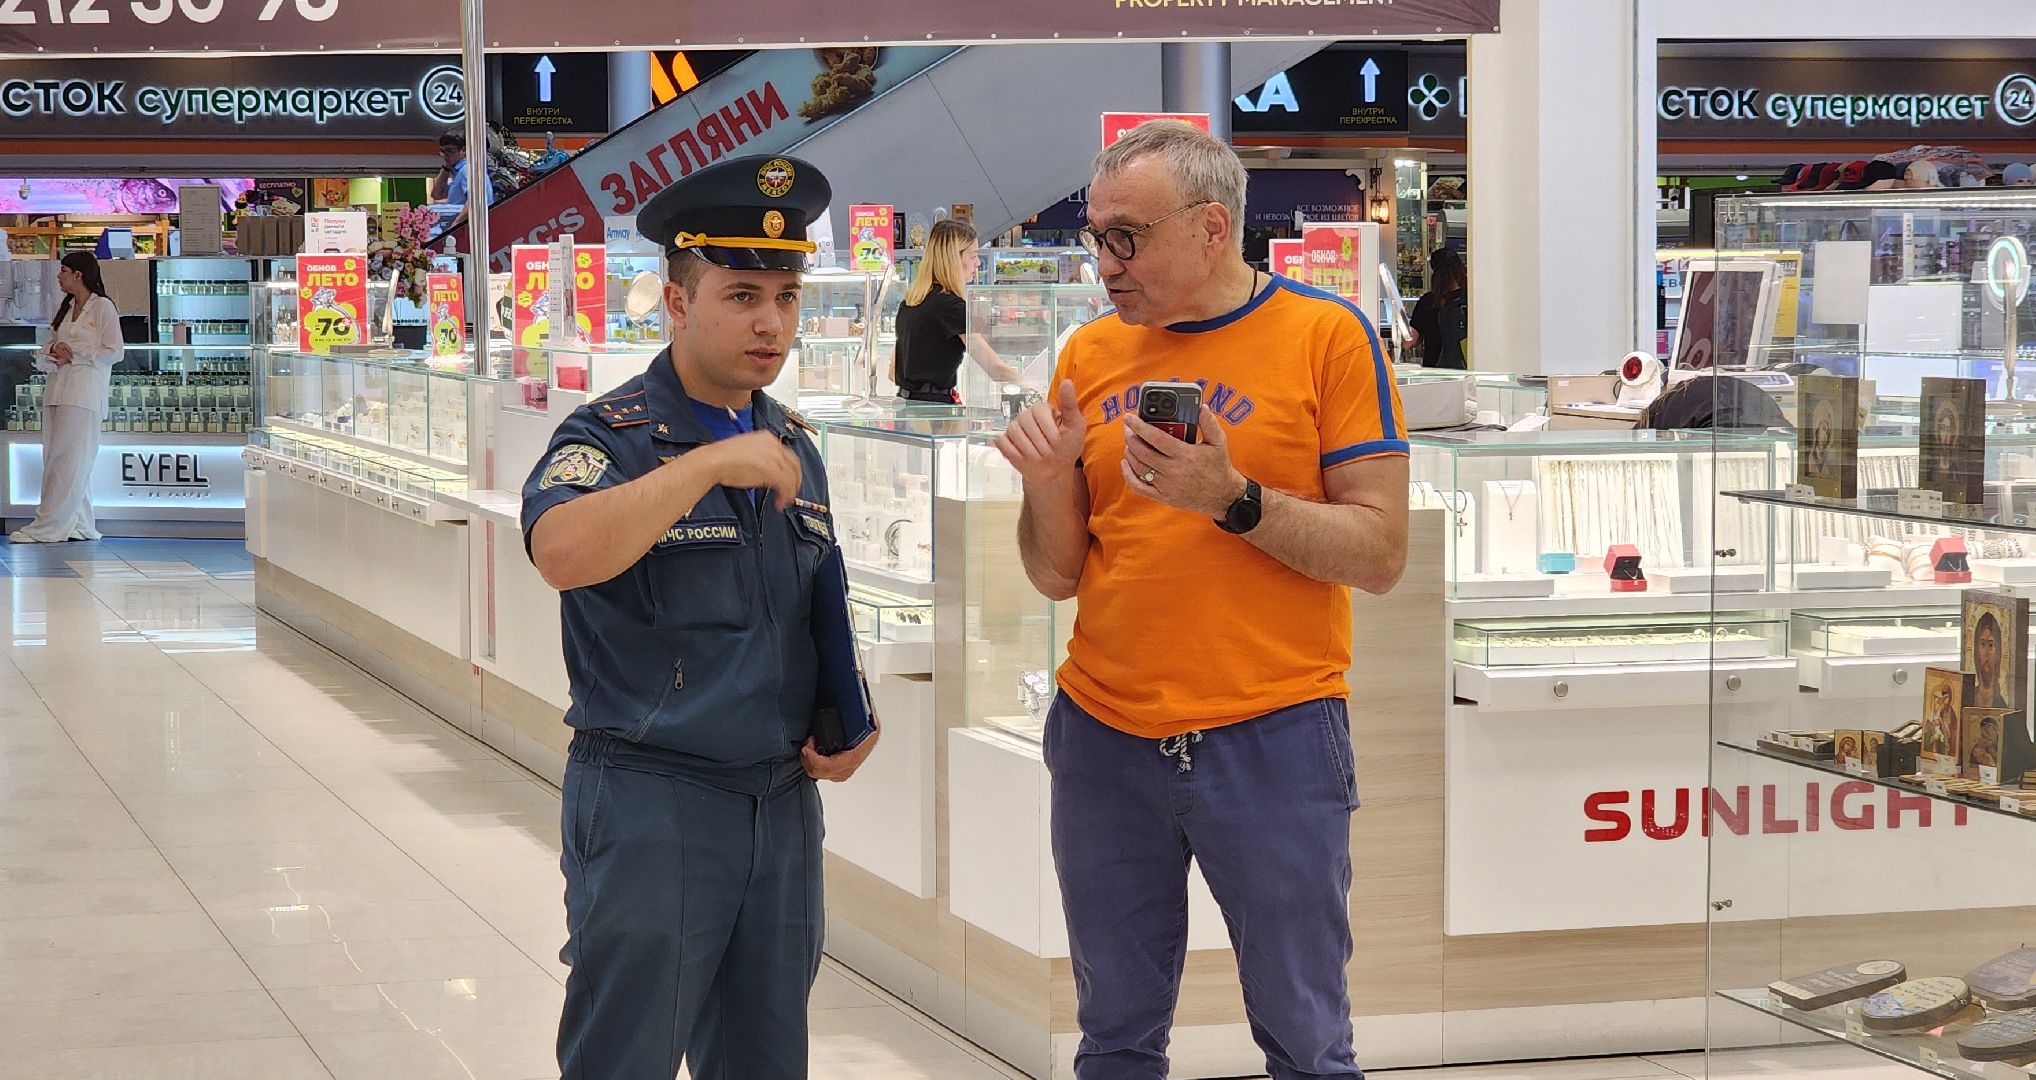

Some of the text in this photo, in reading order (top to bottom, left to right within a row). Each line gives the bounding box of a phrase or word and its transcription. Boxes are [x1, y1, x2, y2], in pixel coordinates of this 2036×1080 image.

[138, 85, 411, 125] супермаркет
[432, 82, 464, 104] 24
[1766, 92, 1992, 128] супермаркет
[2005, 90, 2034, 109] 24
[526, 107, 561, 117] ВНУТРИ
[1352, 107, 1385, 117] ВНУТРИ
[513, 116, 574, 126] ПЕРЕКРЕСТКА
[1339, 115, 1398, 125] ПЕРЕКРЕСТКА
[600, 80, 790, 215] ЗАГЛЯНИ
[1311, 204, 1359, 212] ВОЗМОЖНОЕ
[855, 216, 889, 227] ЛЕТО
[306, 273, 359, 287] ЛЕТО
[525, 271, 596, 291] ЛО
[433, 290, 459, 302] ЛЕТО
[1101, 376, 1255, 425] HOND
[121, 452, 209, 482] EYFEL
[687, 526, 738, 540] РОССИИ
